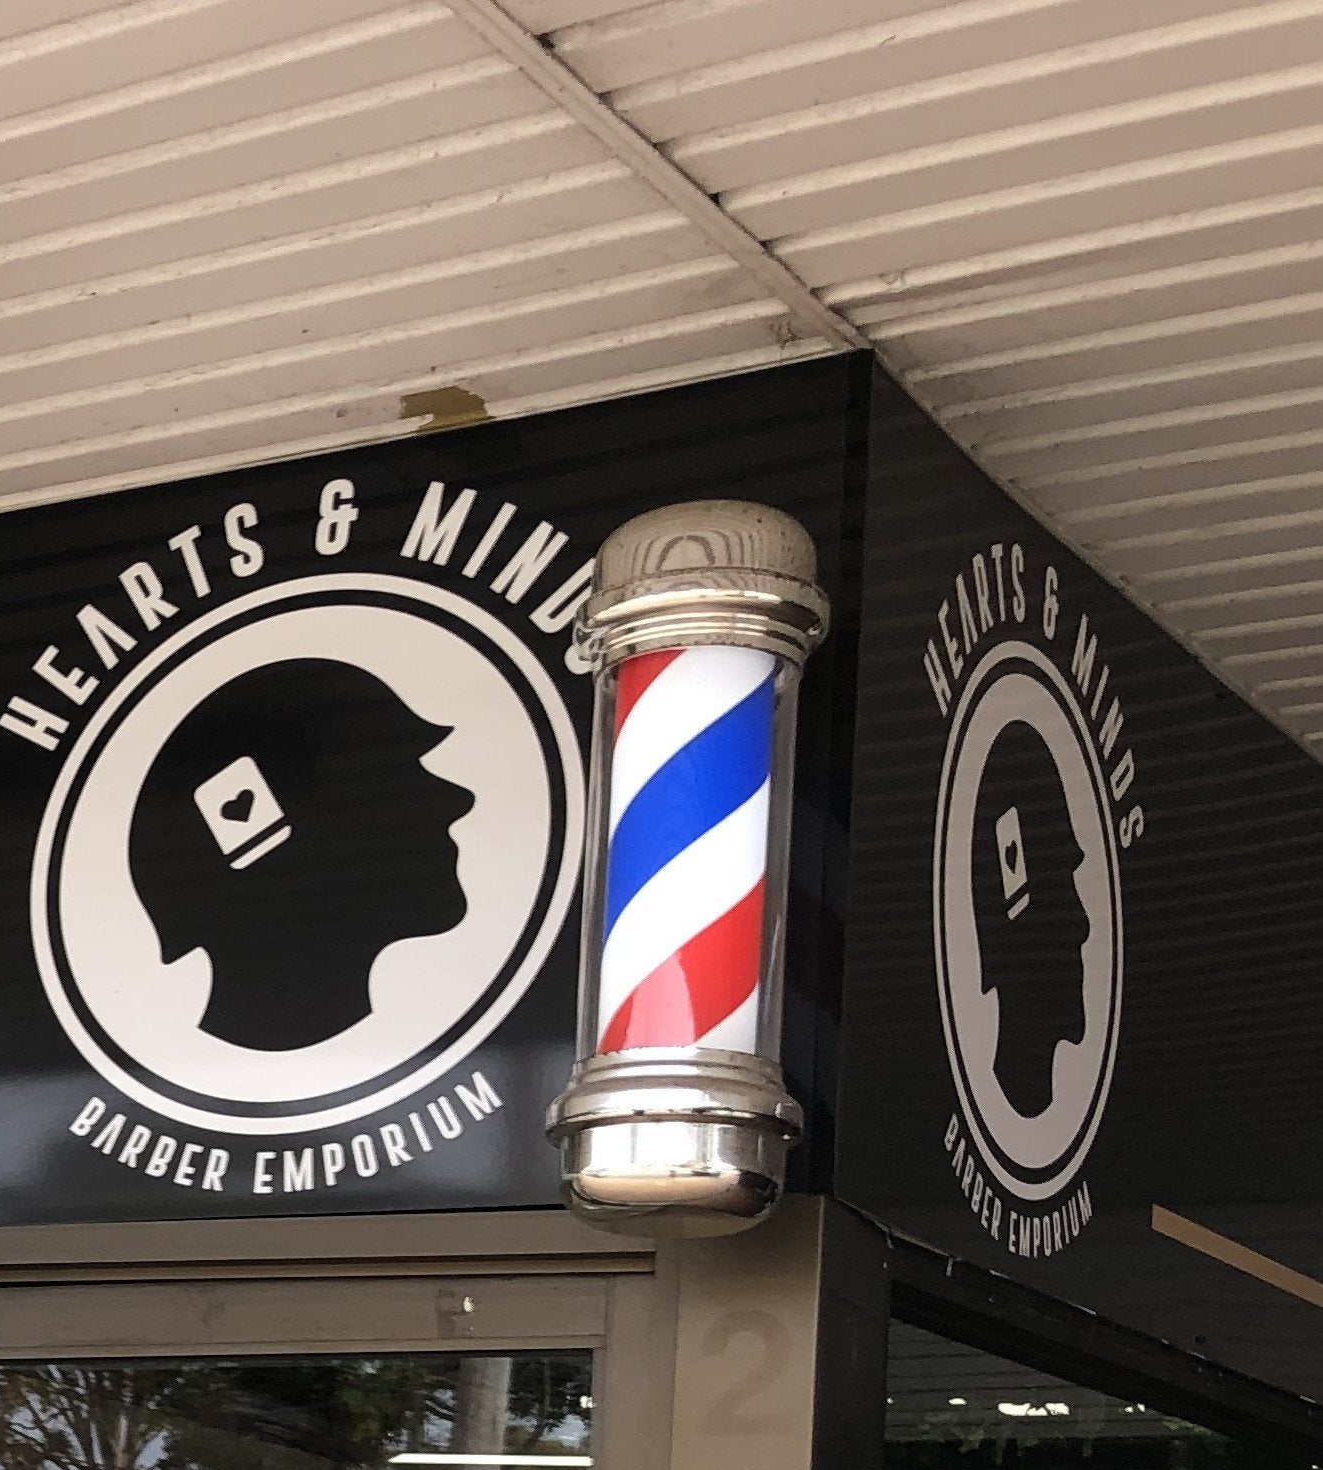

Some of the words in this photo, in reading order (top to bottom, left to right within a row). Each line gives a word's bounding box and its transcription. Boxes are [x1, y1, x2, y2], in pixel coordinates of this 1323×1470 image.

[314, 478, 360, 557] &
[924, 543, 1025, 718] HEARTS
[1043, 565, 1060, 640] &
[1071, 613, 1144, 849] MINDS
[68, 1096, 230, 1193] BARBER
[253, 1070, 504, 1195] EMPORIUM
[944, 1113, 1002, 1241] BARBER
[1009, 1180, 1092, 1259] EMPORIUM
